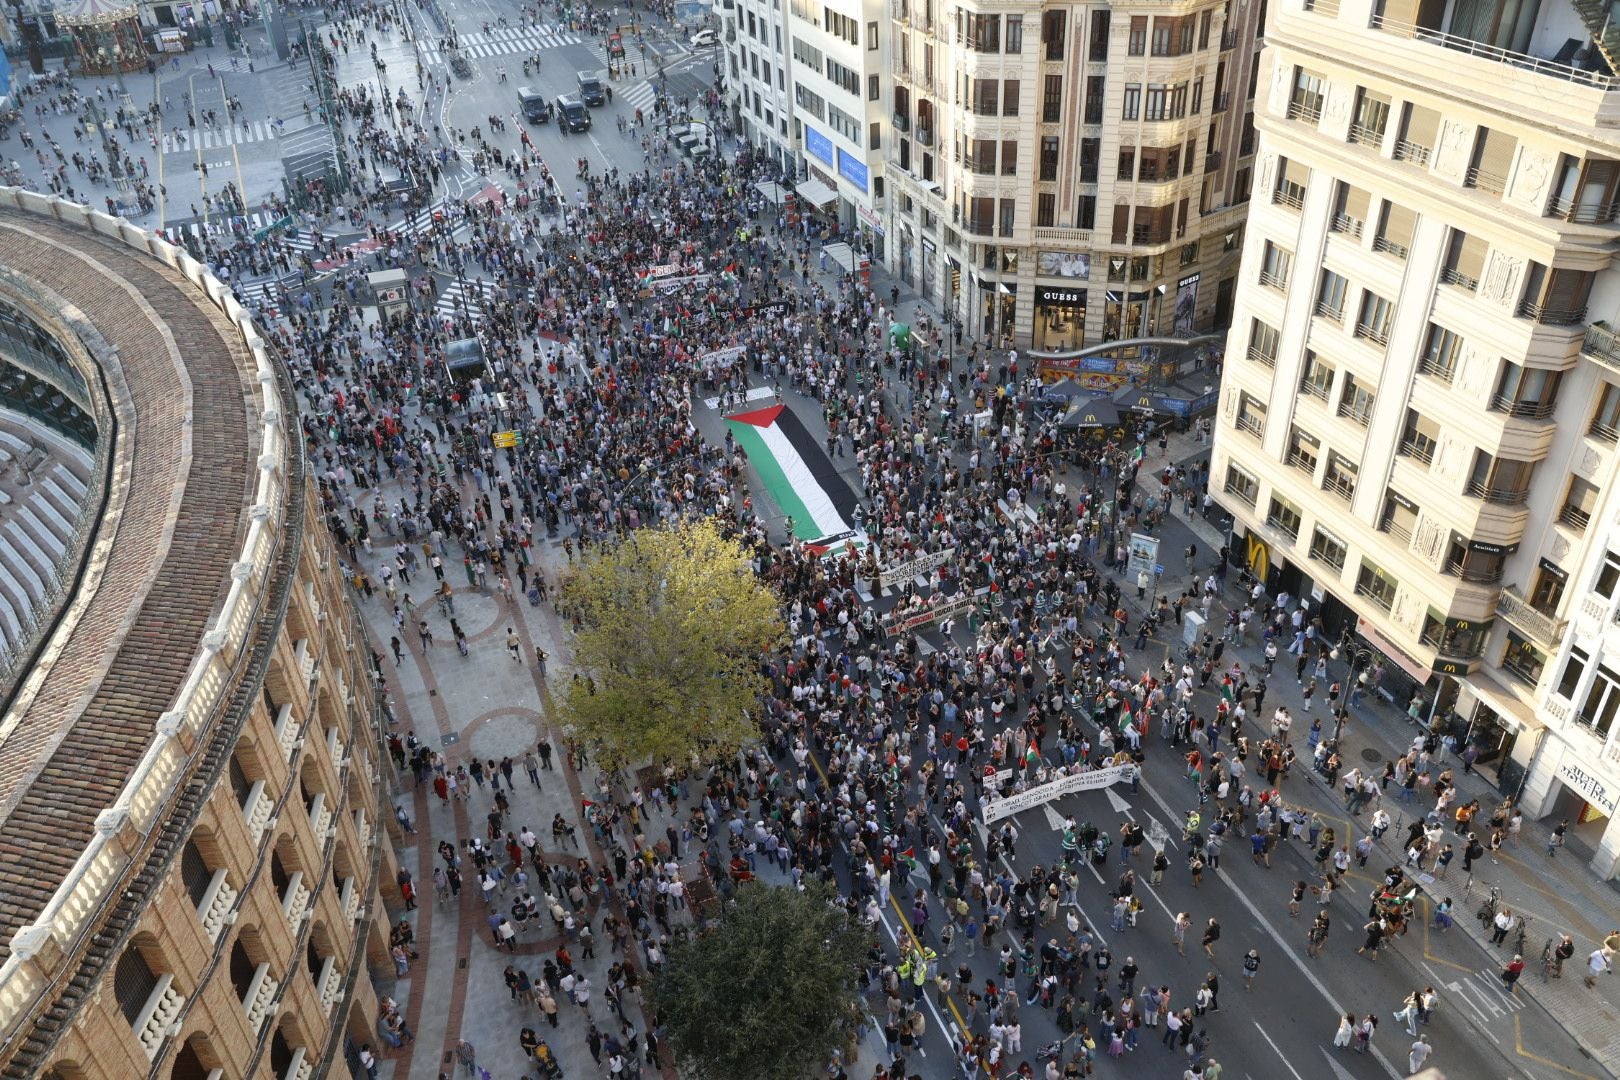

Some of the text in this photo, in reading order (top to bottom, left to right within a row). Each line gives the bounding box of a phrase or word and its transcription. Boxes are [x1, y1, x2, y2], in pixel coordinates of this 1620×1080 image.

[1179, 274, 1200, 287] GUESS
[1043, 292, 1078, 302] GUESS
[759, 304, 785, 315] POBLE
[934, 605, 954, 617] BOICOT
[1001, 797, 1021, 808] ISRAEL
[1022, 786, 1055, 801] GENOCIDA
[1085, 769, 1121, 780] PATROCINA
[1560, 766, 1614, 811] MOMENTS
[1569, 765, 1606, 795] SUPER
[1009, 800, 1033, 811] BOICOT
[1033, 793, 1052, 803] ISRAEL
[1446, 968, 1527, 1022] TAXI
